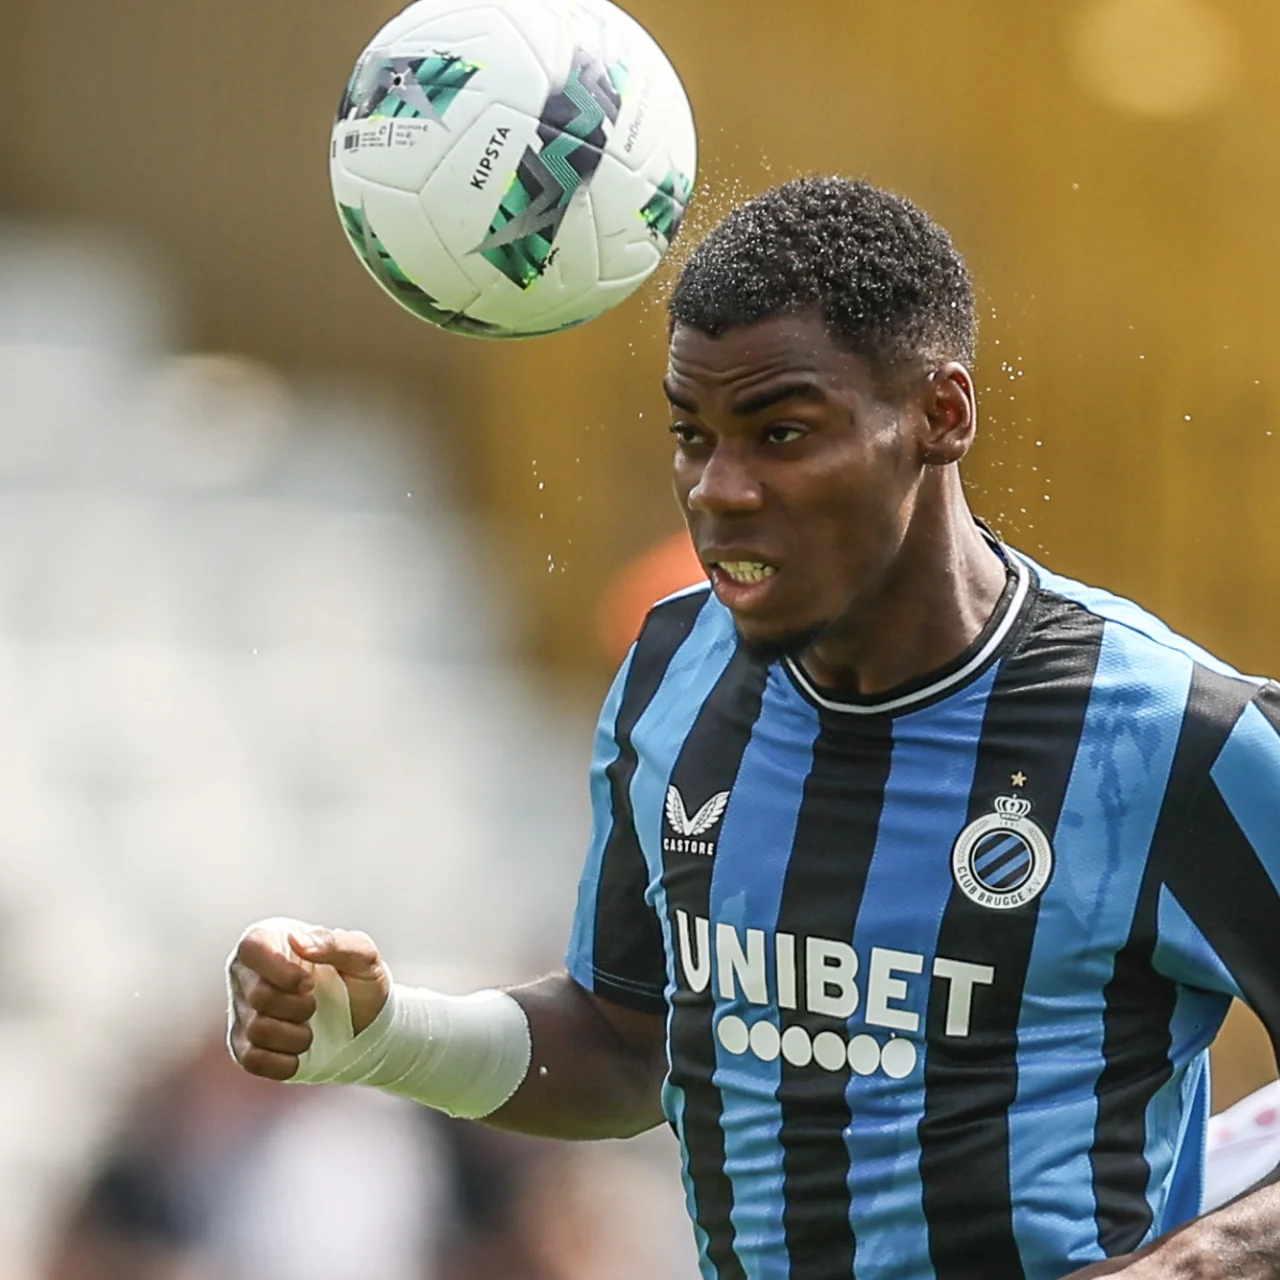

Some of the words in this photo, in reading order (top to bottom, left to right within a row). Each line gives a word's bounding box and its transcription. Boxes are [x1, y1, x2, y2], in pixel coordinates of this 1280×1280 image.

[470, 126, 511, 190] KIPSTA
[663, 838, 715, 856] CASTORE
[957, 866, 978, 895] CLUB
[977, 891, 1026, 907] BRUGGE
[675, 909, 995, 1038] UNIBET
